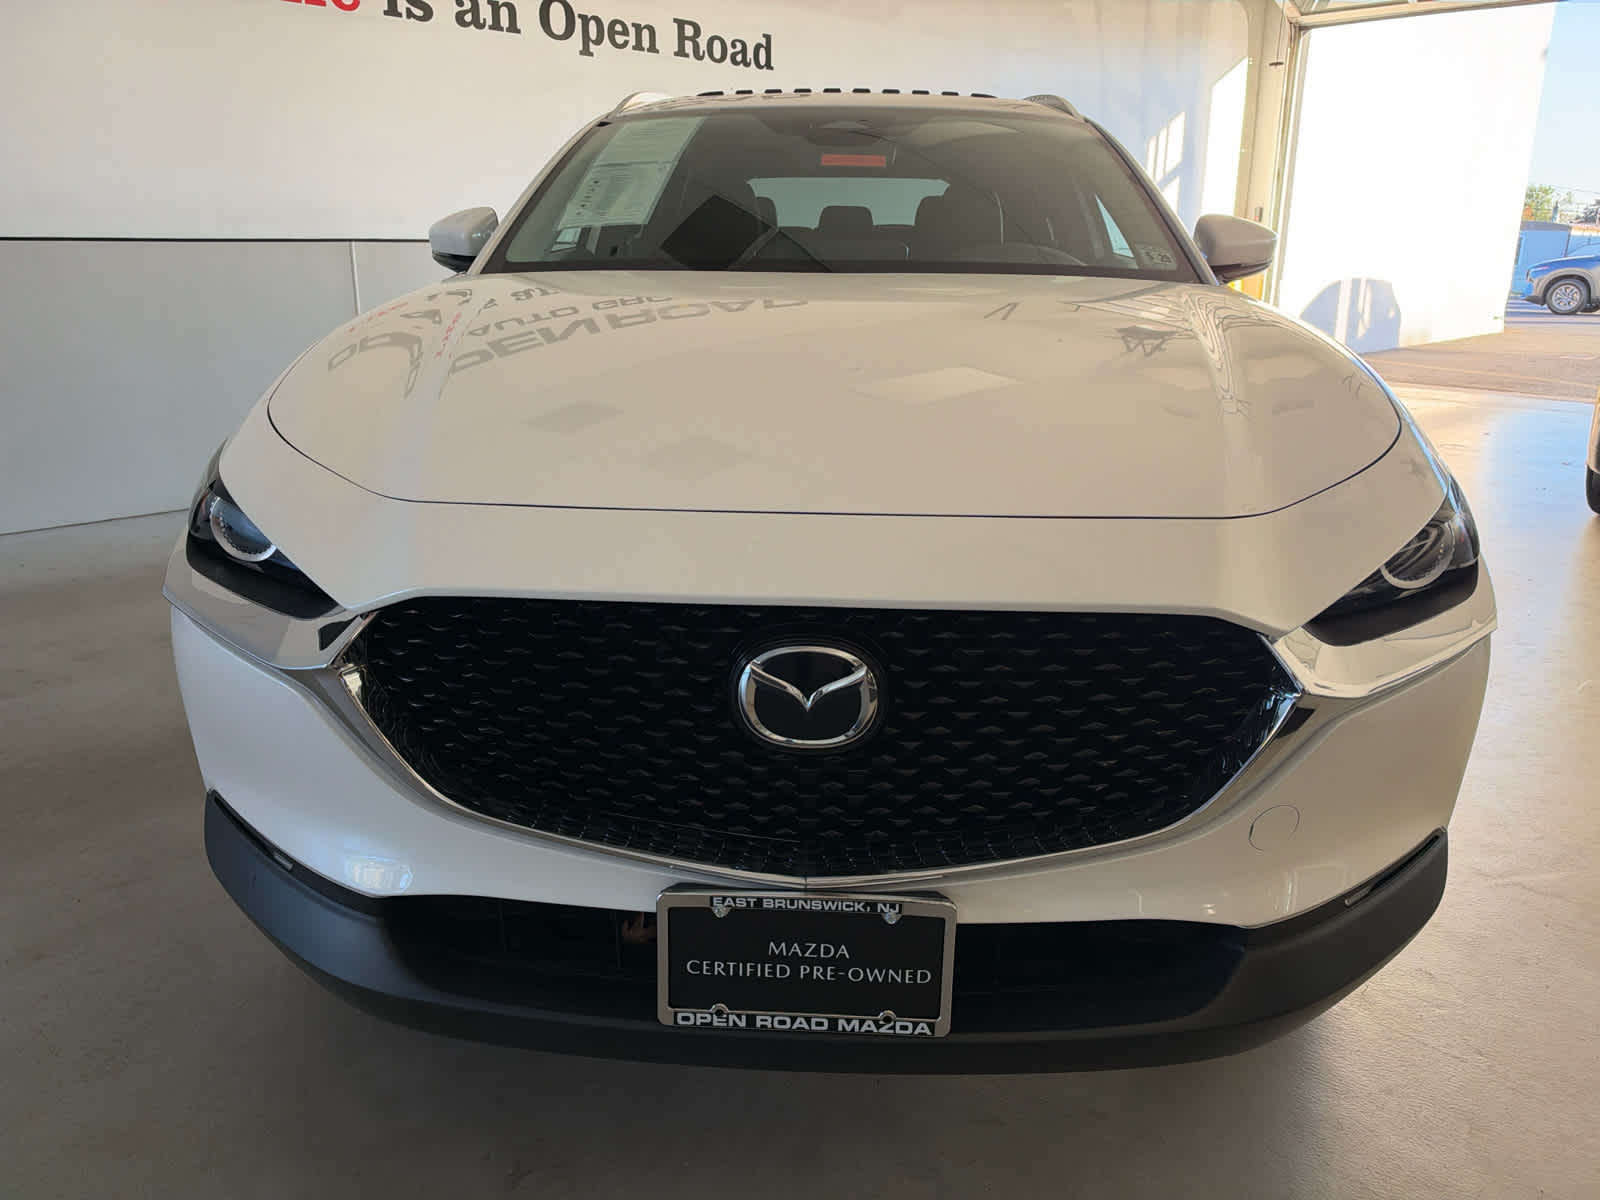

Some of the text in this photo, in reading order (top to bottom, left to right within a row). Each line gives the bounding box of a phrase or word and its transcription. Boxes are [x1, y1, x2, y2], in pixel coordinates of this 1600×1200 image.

[454, 0, 522, 34] an
[538, 0, 660, 57] Open
[672, 17, 775, 71] Road
[712, 896, 900, 913] EAST BRUNSWICK, NJ
[768, 941, 850, 959] MAZDA
[686, 959, 932, 984] CERTIFIED PRE-OWNED
[676, 1012, 932, 1036] OPEN ROAD MAZDA
